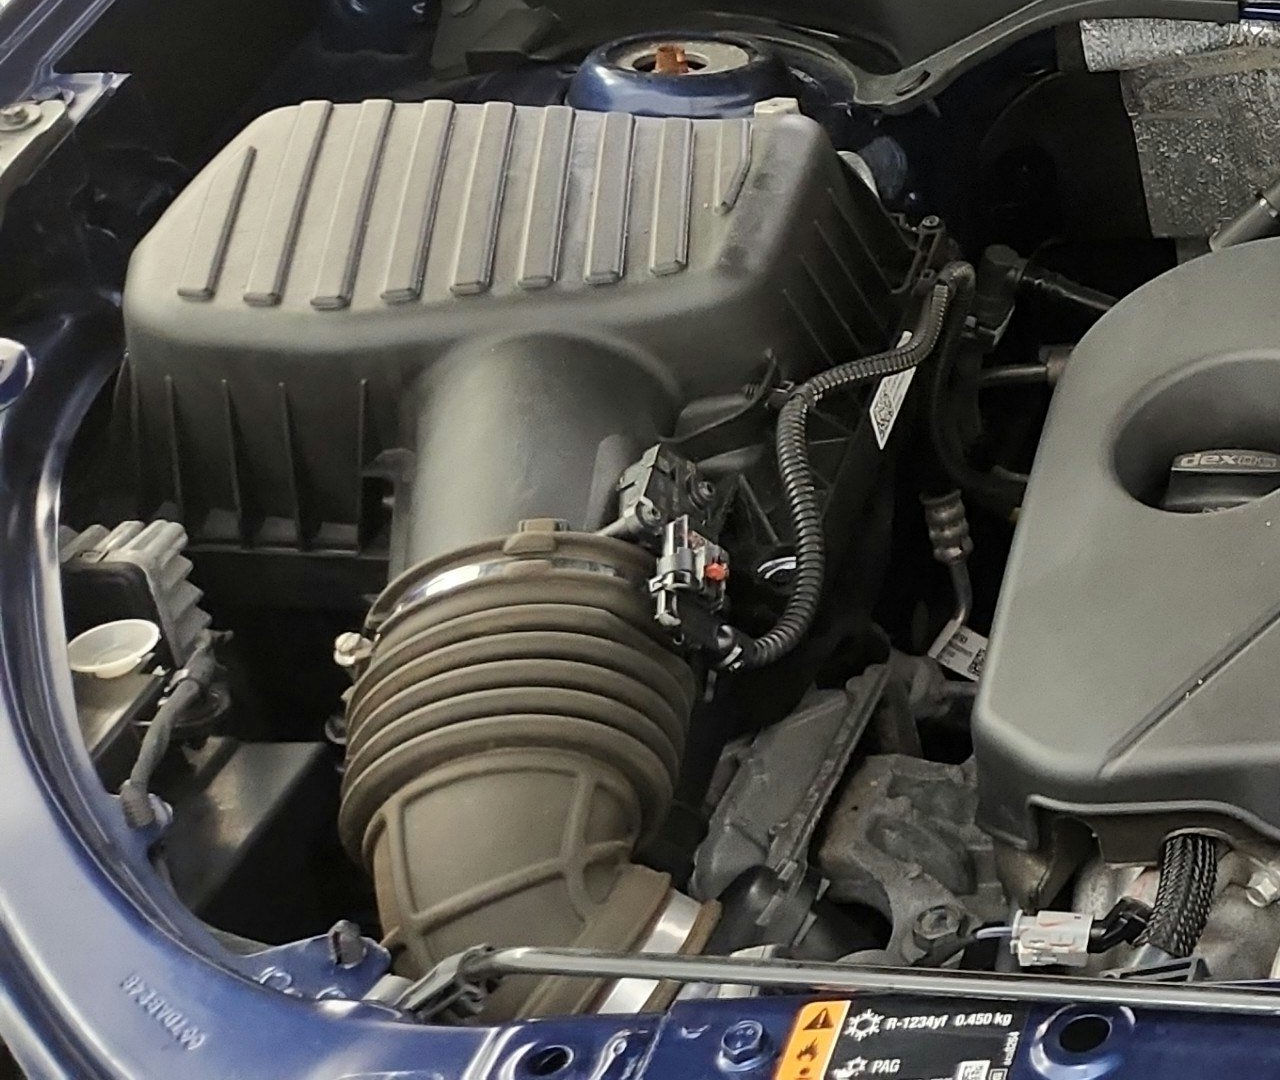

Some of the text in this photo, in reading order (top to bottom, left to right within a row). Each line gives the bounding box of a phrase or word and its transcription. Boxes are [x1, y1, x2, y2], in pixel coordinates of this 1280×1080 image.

[886, 1012, 1013, 1030] R-1234yf 0.450 kg
[872, 1058, 900, 1073] PAG
